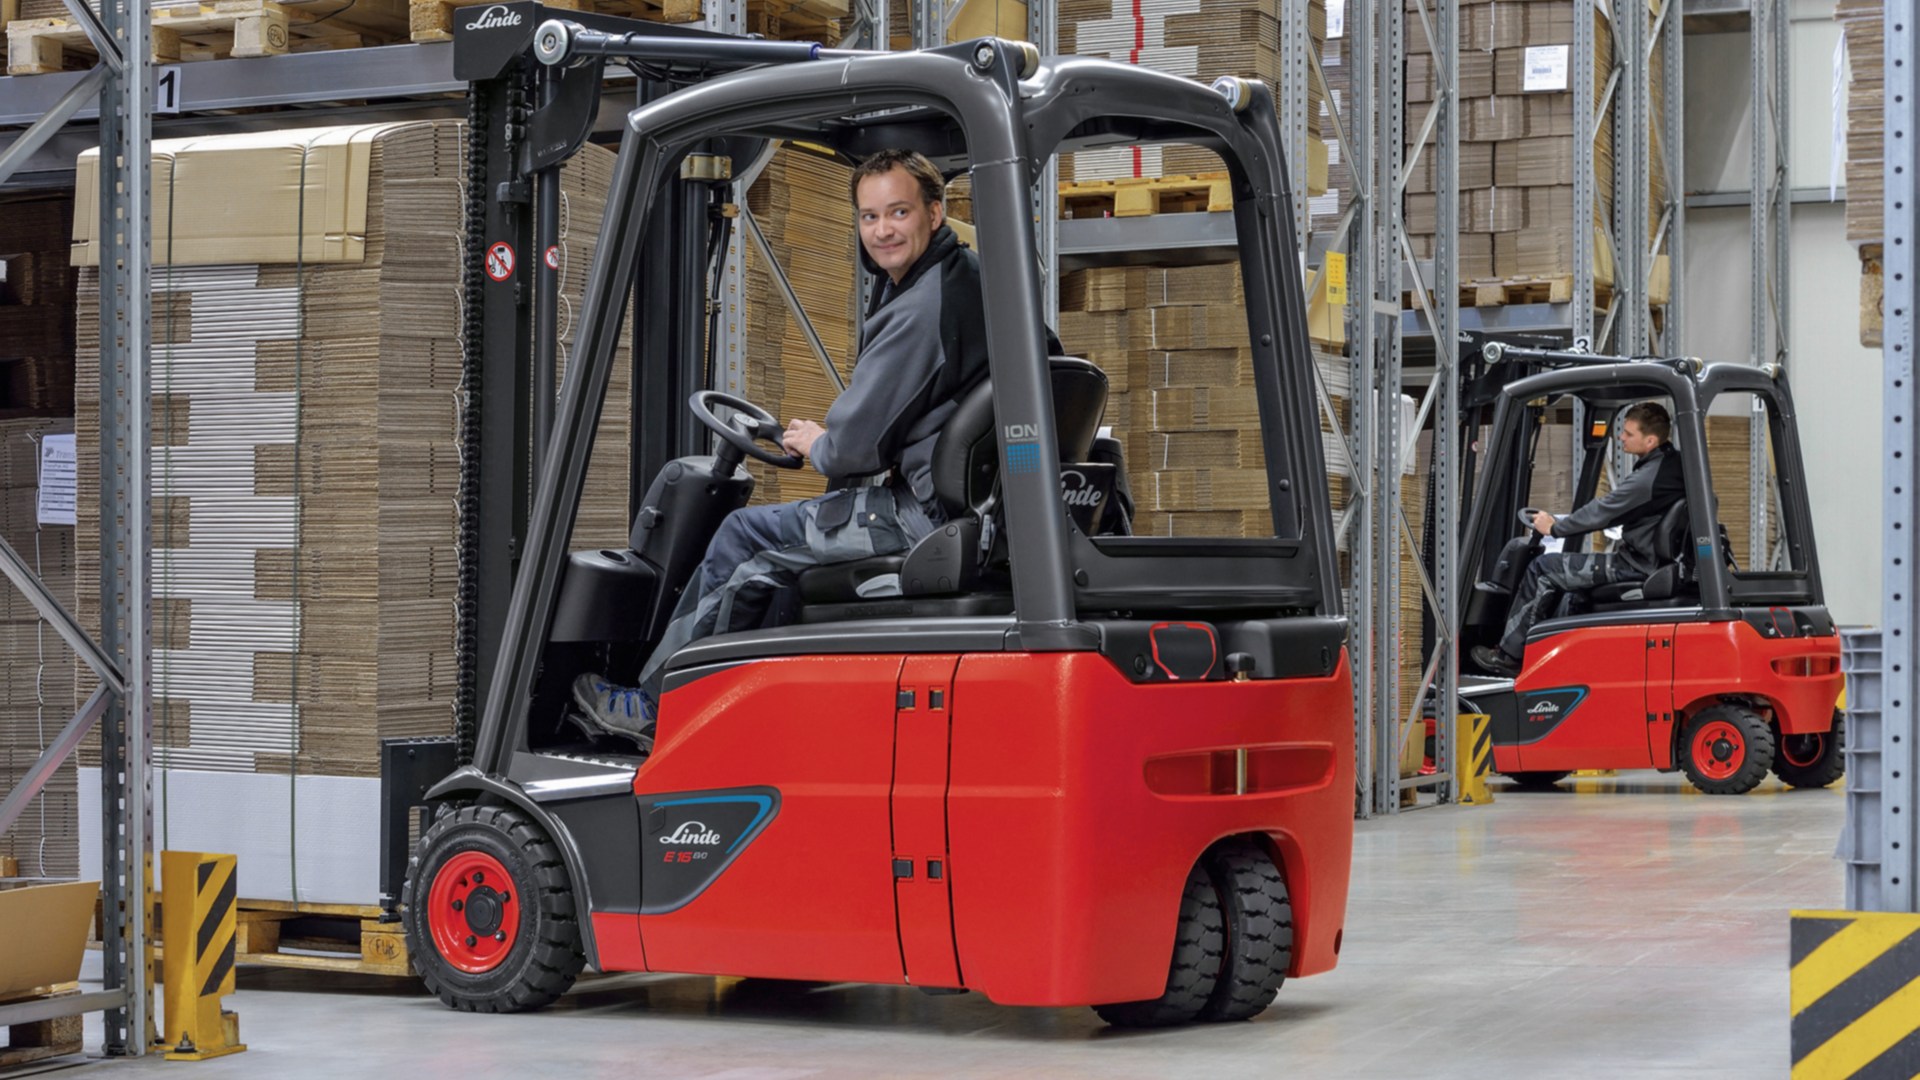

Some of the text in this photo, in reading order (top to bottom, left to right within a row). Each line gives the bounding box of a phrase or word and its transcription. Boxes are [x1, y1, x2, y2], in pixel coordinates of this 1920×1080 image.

[465, 5, 522, 30] Linde
[160, 70, 175, 108] 1
[1576, 338, 1590, 354] 3
[1005, 424, 1038, 438] ION
[1527, 700, 1560, 713] Linde
[659, 820, 721, 845] Linde
[663, 851, 676, 863] E
